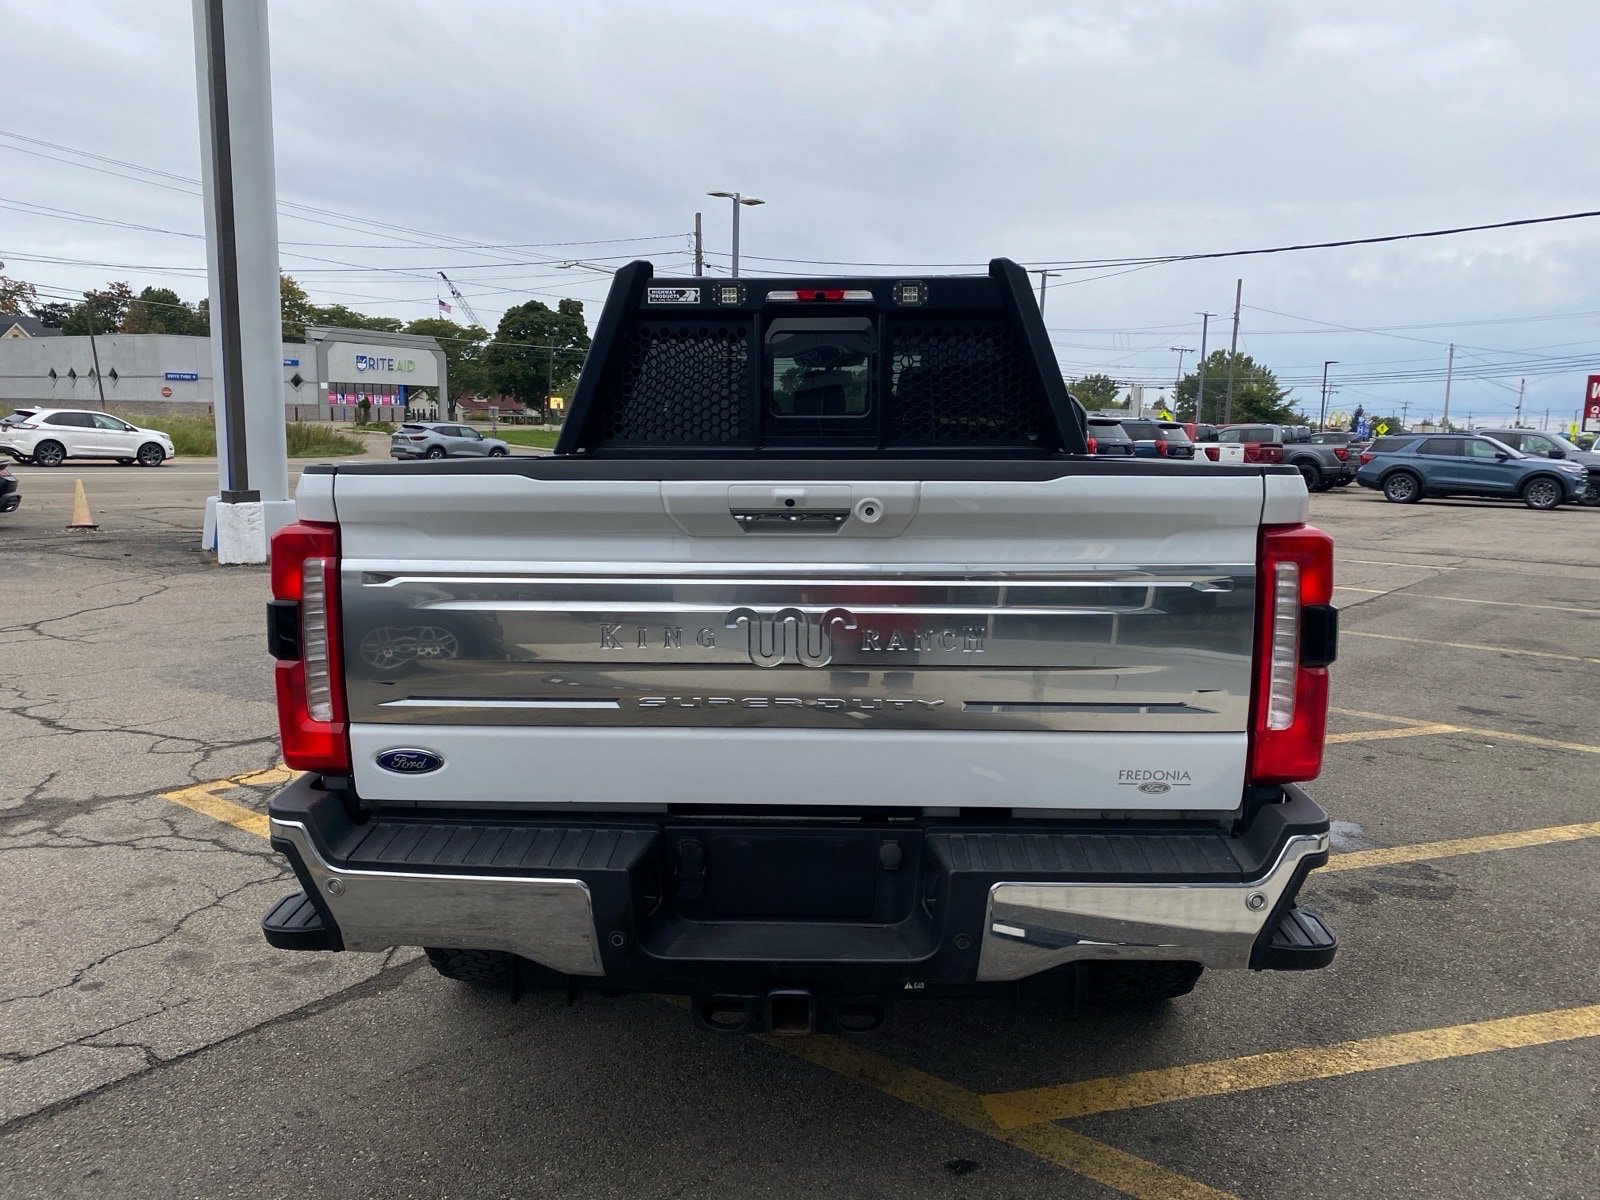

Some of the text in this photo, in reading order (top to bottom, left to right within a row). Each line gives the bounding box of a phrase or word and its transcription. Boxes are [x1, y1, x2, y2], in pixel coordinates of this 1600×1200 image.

[368, 358, 415, 372] RITE AID
[600, 624, 986, 653] KING RANCH
[639, 697, 944, 711] SUPER DUTY
[391, 753, 427, 769] Ford
[1118, 770, 1191, 781] FREDONIA
